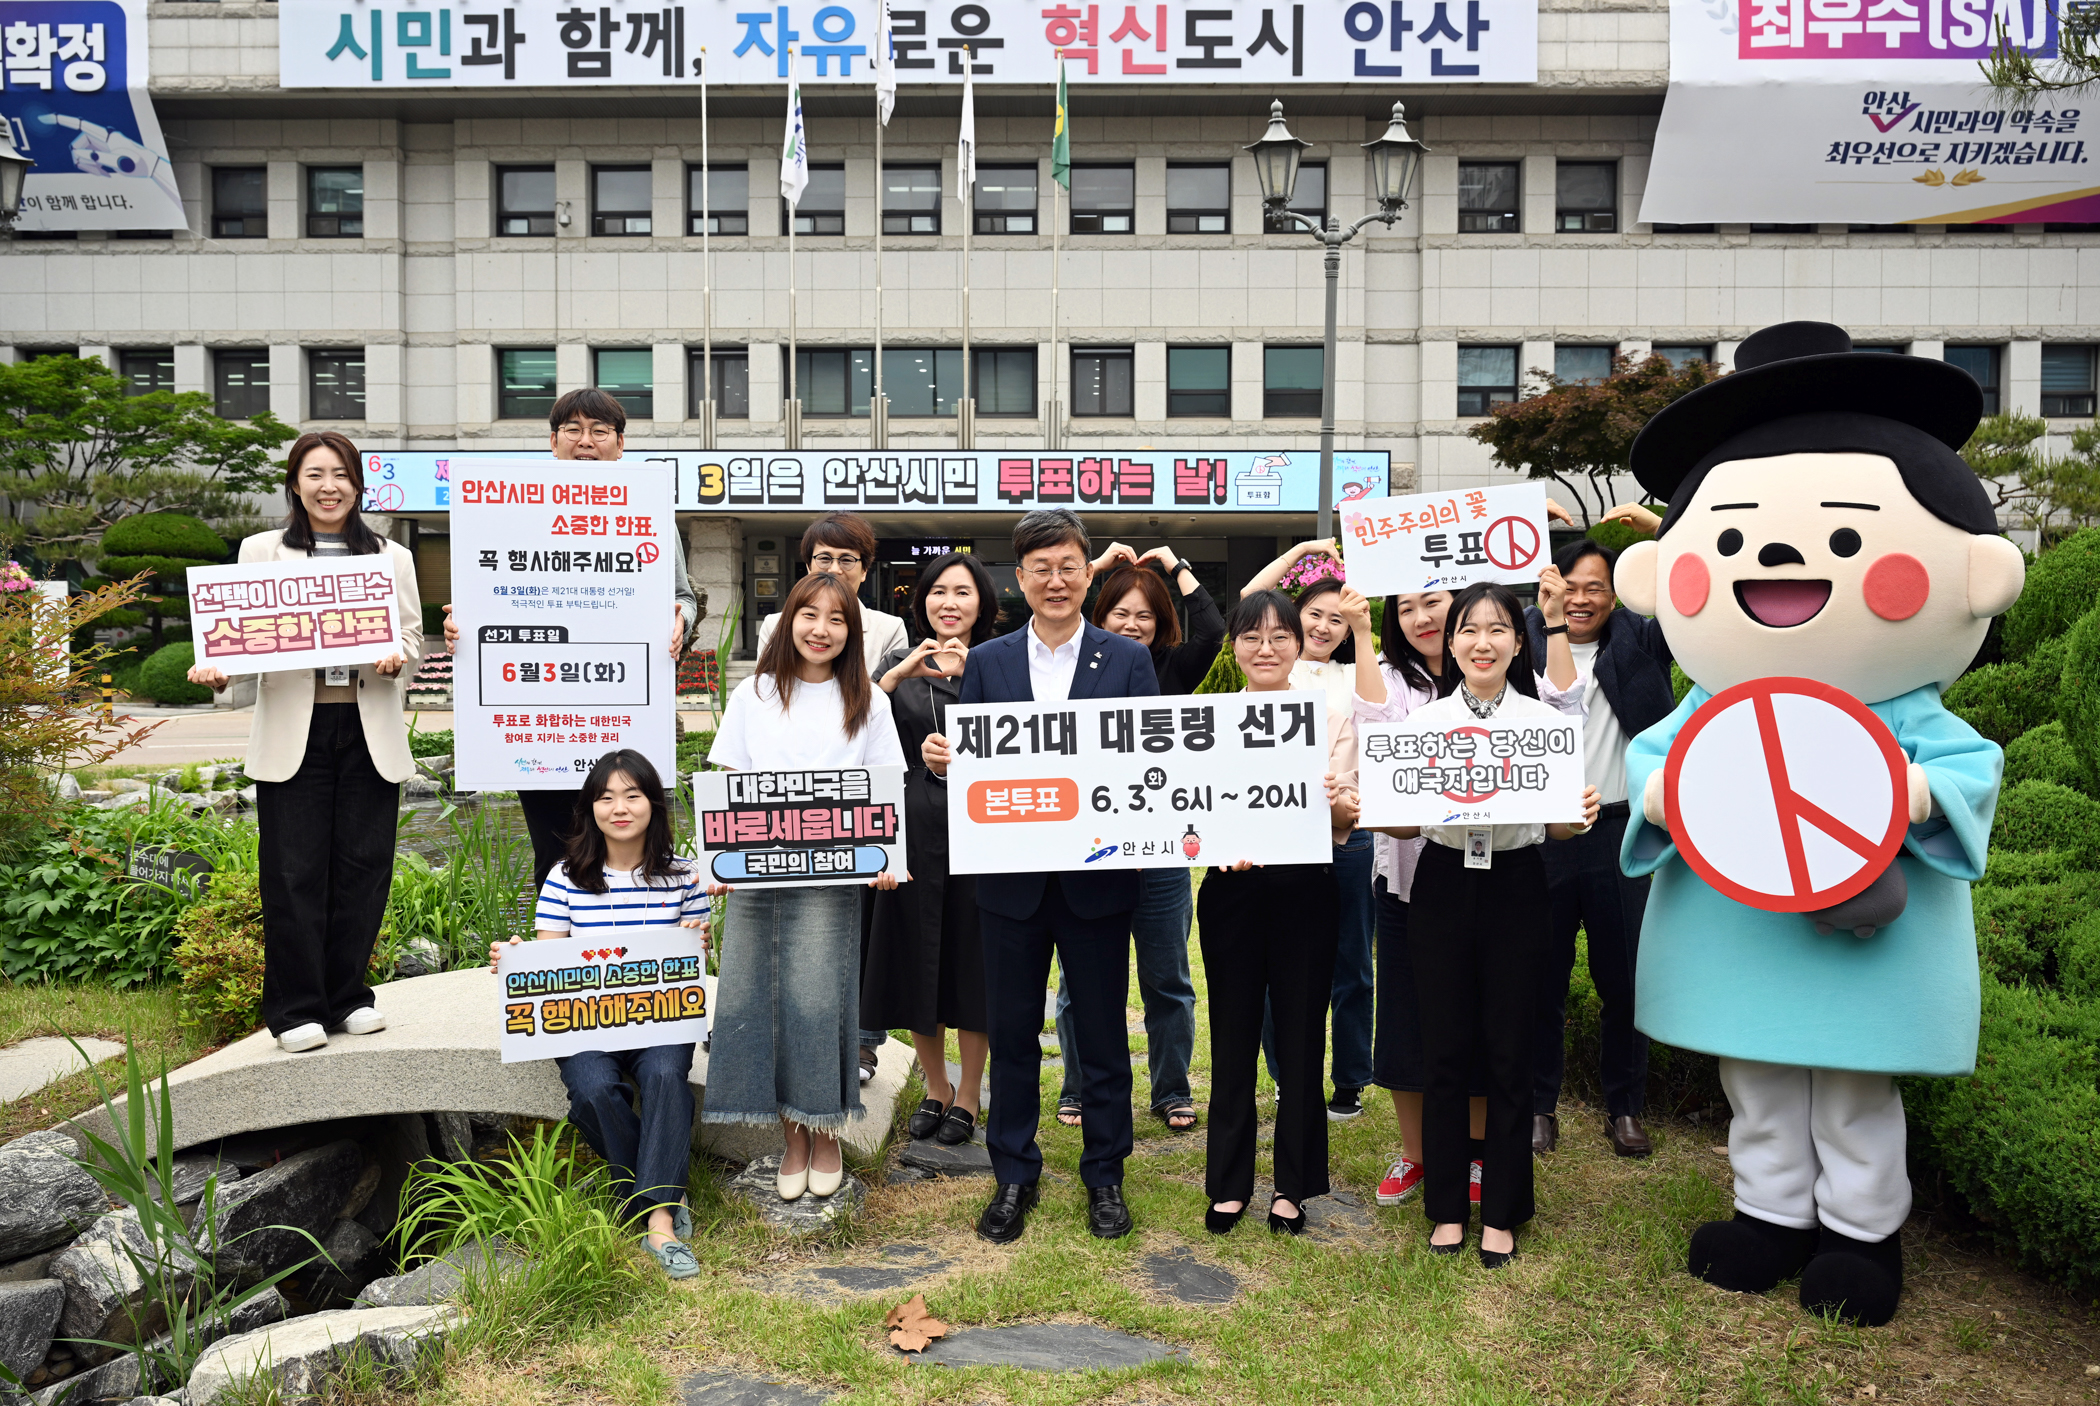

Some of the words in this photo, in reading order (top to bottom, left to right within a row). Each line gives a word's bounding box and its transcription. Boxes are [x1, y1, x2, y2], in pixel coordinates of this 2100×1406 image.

[326, 7, 526, 81] 시민과
[733, 4, 1004, 77] 자유로운
[1042, 4, 1303, 76] 혁신도시
[1344, 0, 1490, 76] 안산
[0, 21, 106, 92] 확정
[1862, 91, 1911, 116] 안산
[1909, 110, 2005, 134] 시민과의
[2010, 109, 2081, 134] 약속을
[1825, 141, 1941, 165] 최우선으로
[1944, 140, 2089, 165] 지키겠습니다.
[46, 194, 78, 211] 함께
[80, 194, 133, 211] 합니다.
[368, 455, 381, 472] 6
[382, 463, 395, 480] 3
[462, 480, 545, 504] 안산시민
[552, 484, 628, 506] 여러분의
[698, 458, 804, 504] 3일은
[823, 458, 978, 504] 안산시민
[998, 457, 1154, 504] 투표하는
[1174, 458, 1228, 505] 날!
[1246, 490, 1271, 499] 투표함
[551, 515, 609, 535] 소중한
[1355, 498, 1461, 547] 민주주의의
[1464, 490, 1488, 520] 꽃
[478, 550, 499, 571] 꼭
[507, 550, 643, 573] 행사해주세요!
[1420, 531, 1489, 568] 투표
[192, 578, 278, 614] 선택이
[279, 574, 336, 607] 아닌
[336, 571, 393, 603] 필수
[493, 585, 508, 596] 6월
[551, 587, 578, 596] 제21대
[580, 587, 605, 596] 대통령
[607, 587, 635, 597] 선거일!
[511, 600, 544, 609] 적극적인
[547, 600, 564, 609] 투표
[566, 600, 618, 610] 부탁드립니다.
[203, 611, 317, 658] 소중한
[317, 606, 394, 649] 한표
[484, 629, 513, 642] 선거
[518, 629, 560, 642] 투표일
[492, 714, 531, 728] 투표로
[535, 714, 586, 727] 화합하는
[590, 715, 632, 727] 대한민국
[956, 711, 1078, 758] 제21대
[1099, 705, 1216, 753] 대통령
[1238, 702, 1316, 748] 선거
[504, 732, 533, 743] 참여로
[536, 733, 565, 743] 지키는
[568, 733, 597, 743] 소중한
[600, 732, 619, 743] 권리
[1365, 731, 1477, 763] 투표하는
[1490, 727, 1575, 758] 당신이
[727, 769, 871, 804] 대한민국을
[1147, 771, 1164, 787] 화
[1393, 763, 1549, 794] 애국자입니다
[985, 787, 1062, 816] 본투표
[1171, 785, 1213, 812] 6시
[1247, 782, 1307, 809] 20시
[703, 804, 899, 850] 바로세웁니다
[745, 851, 809, 875] 국민의
[811, 848, 856, 874] 참여
[506, 964, 602, 999] 안산시민의
[604, 957, 660, 990] 소중한
[662, 956, 700, 984] 한표
[505, 1002, 536, 1037] 꼭
[541, 985, 706, 1035] 행사해주세요
